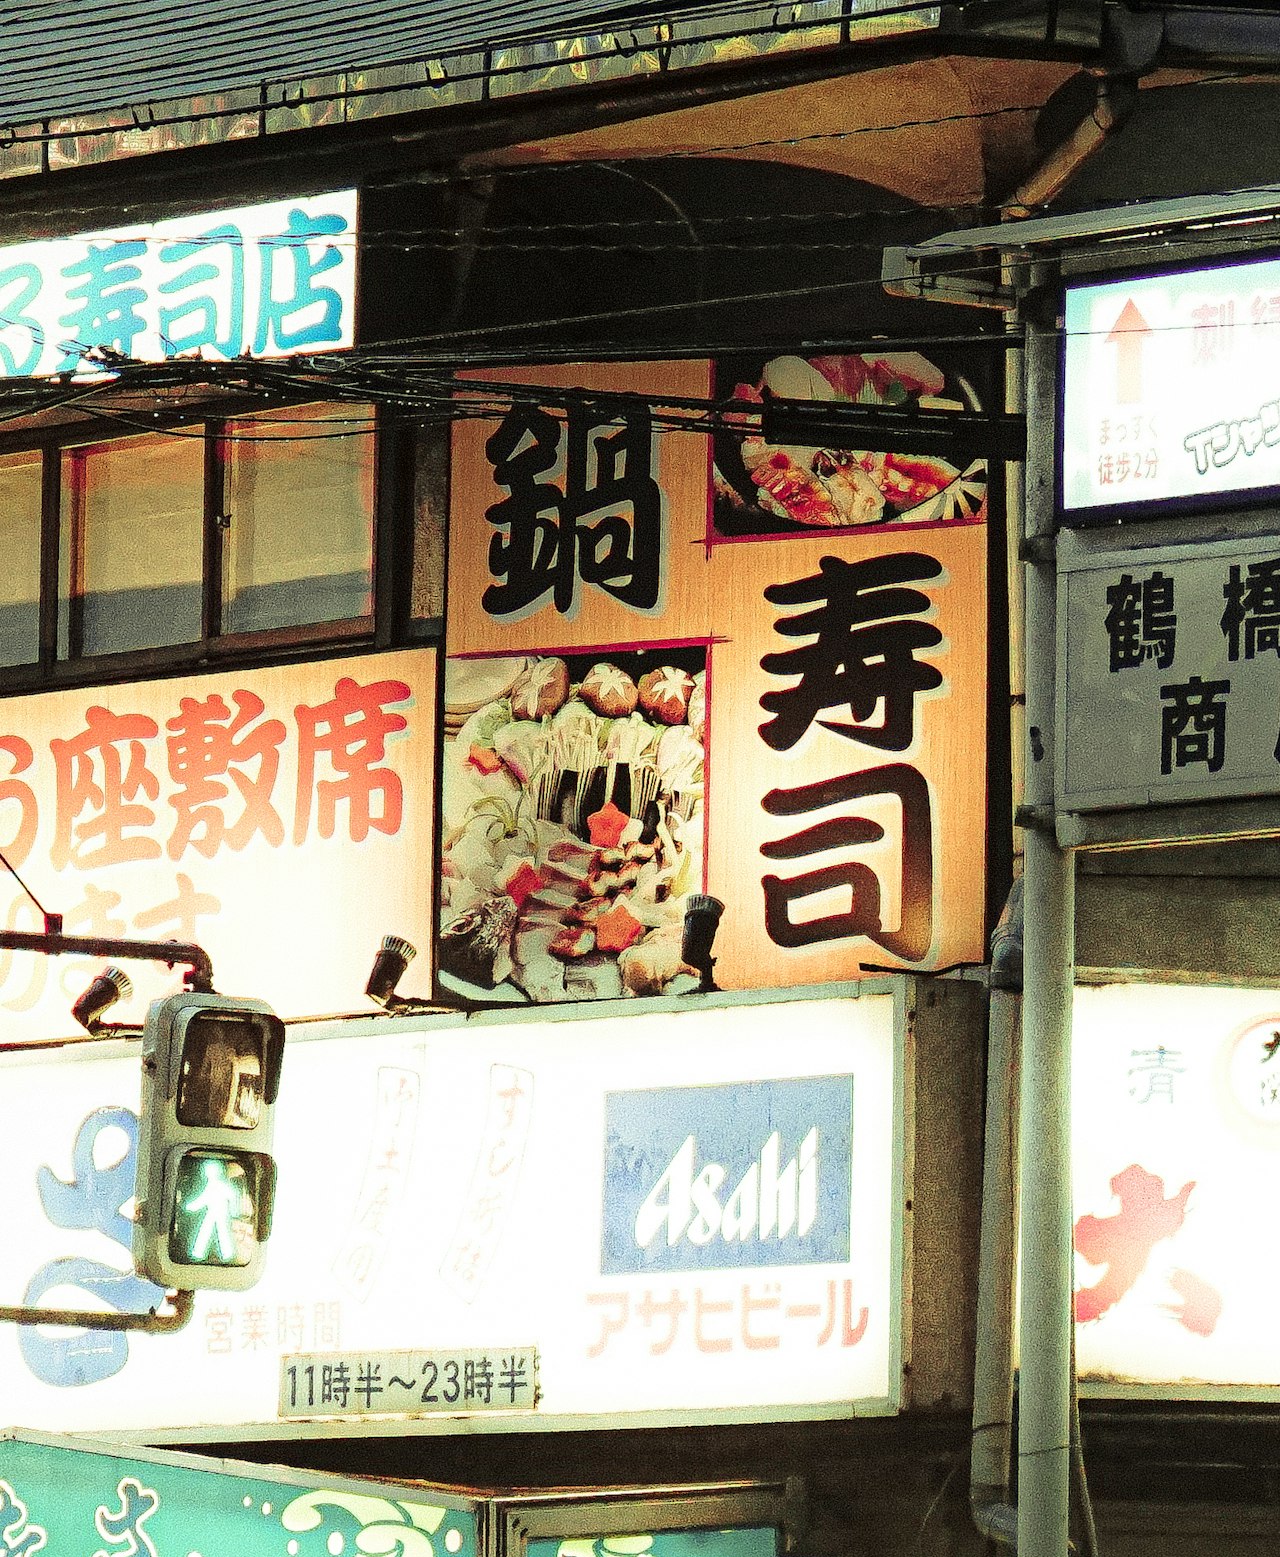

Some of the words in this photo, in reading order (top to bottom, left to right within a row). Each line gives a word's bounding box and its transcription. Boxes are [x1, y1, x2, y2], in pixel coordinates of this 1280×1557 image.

[482, 405, 662, 616] 鍋
[759, 553, 945, 964] 寿司
[634, 1124, 819, 1249] Asahi
[204, 1300, 342, 1353] 営業時間
[586, 1277, 869, 1358] アサヒビール
